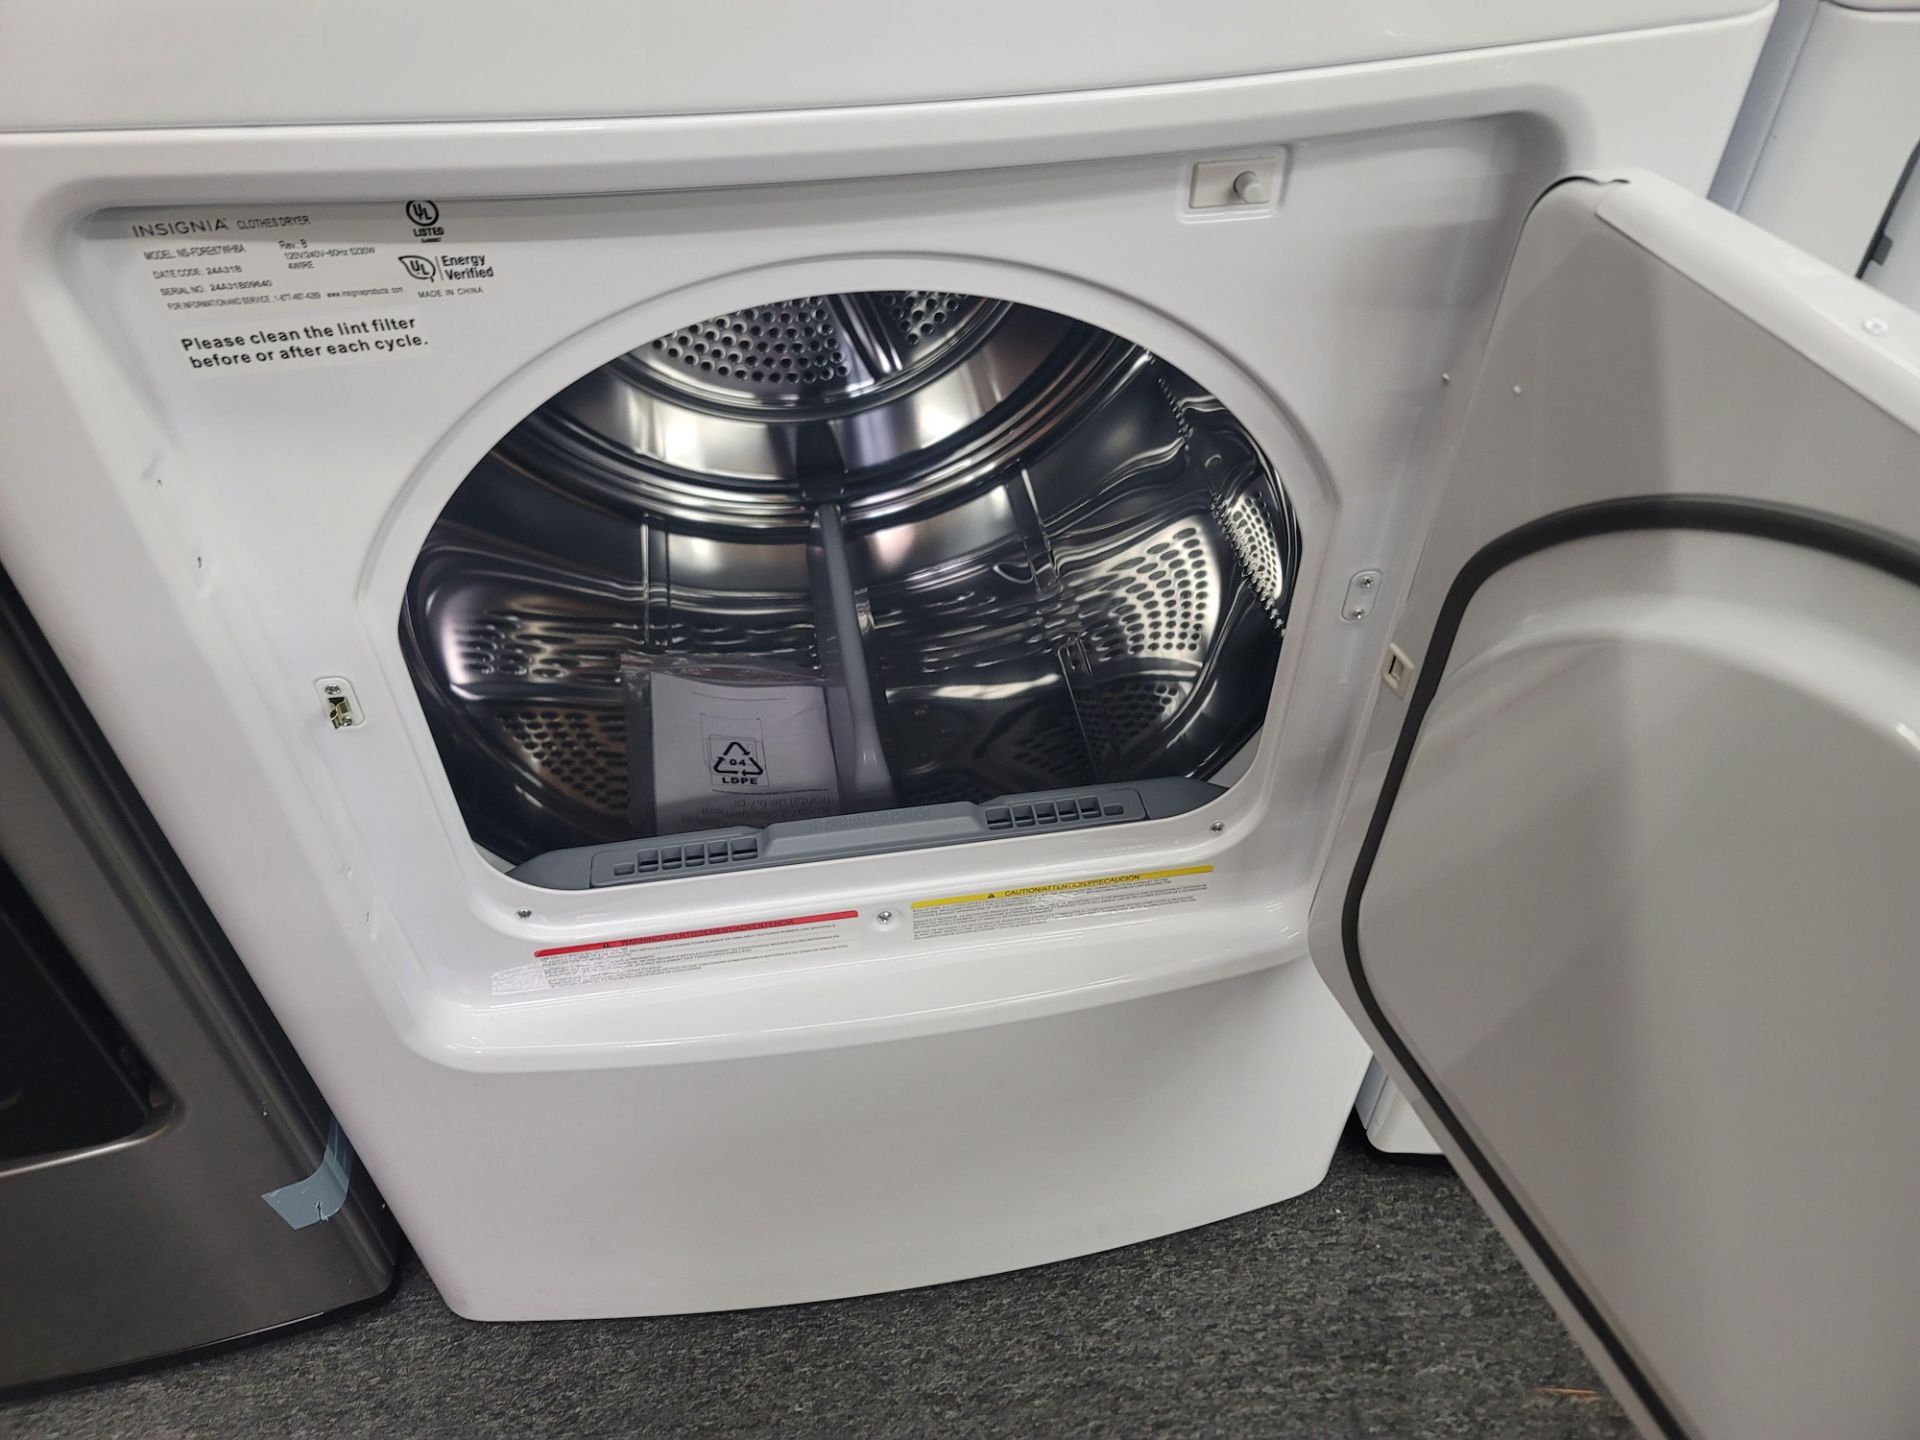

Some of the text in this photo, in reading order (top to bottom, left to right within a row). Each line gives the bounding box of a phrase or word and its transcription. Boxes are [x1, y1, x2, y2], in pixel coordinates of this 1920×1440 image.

[132, 215, 310, 238] INSIGNIA CLOTHES DRYER
[413, 226, 445, 238] LISTED
[442, 254, 486, 268] Energy
[153, 269, 177, 280] DATE
[445, 266, 494, 281] Verified
[160, 285, 190, 297] SERIAL
[417, 286, 484, 299] MADE IN CHINA
[167, 301, 182, 311] FOR
[182, 298, 225, 310] INFORMATION
[181, 316, 416, 353] Please clean the lint filter
[189, 333, 429, 370] before or after each cycle.
[729, 758, 746, 766] 04
[721, 776, 759, 785] LDPE
